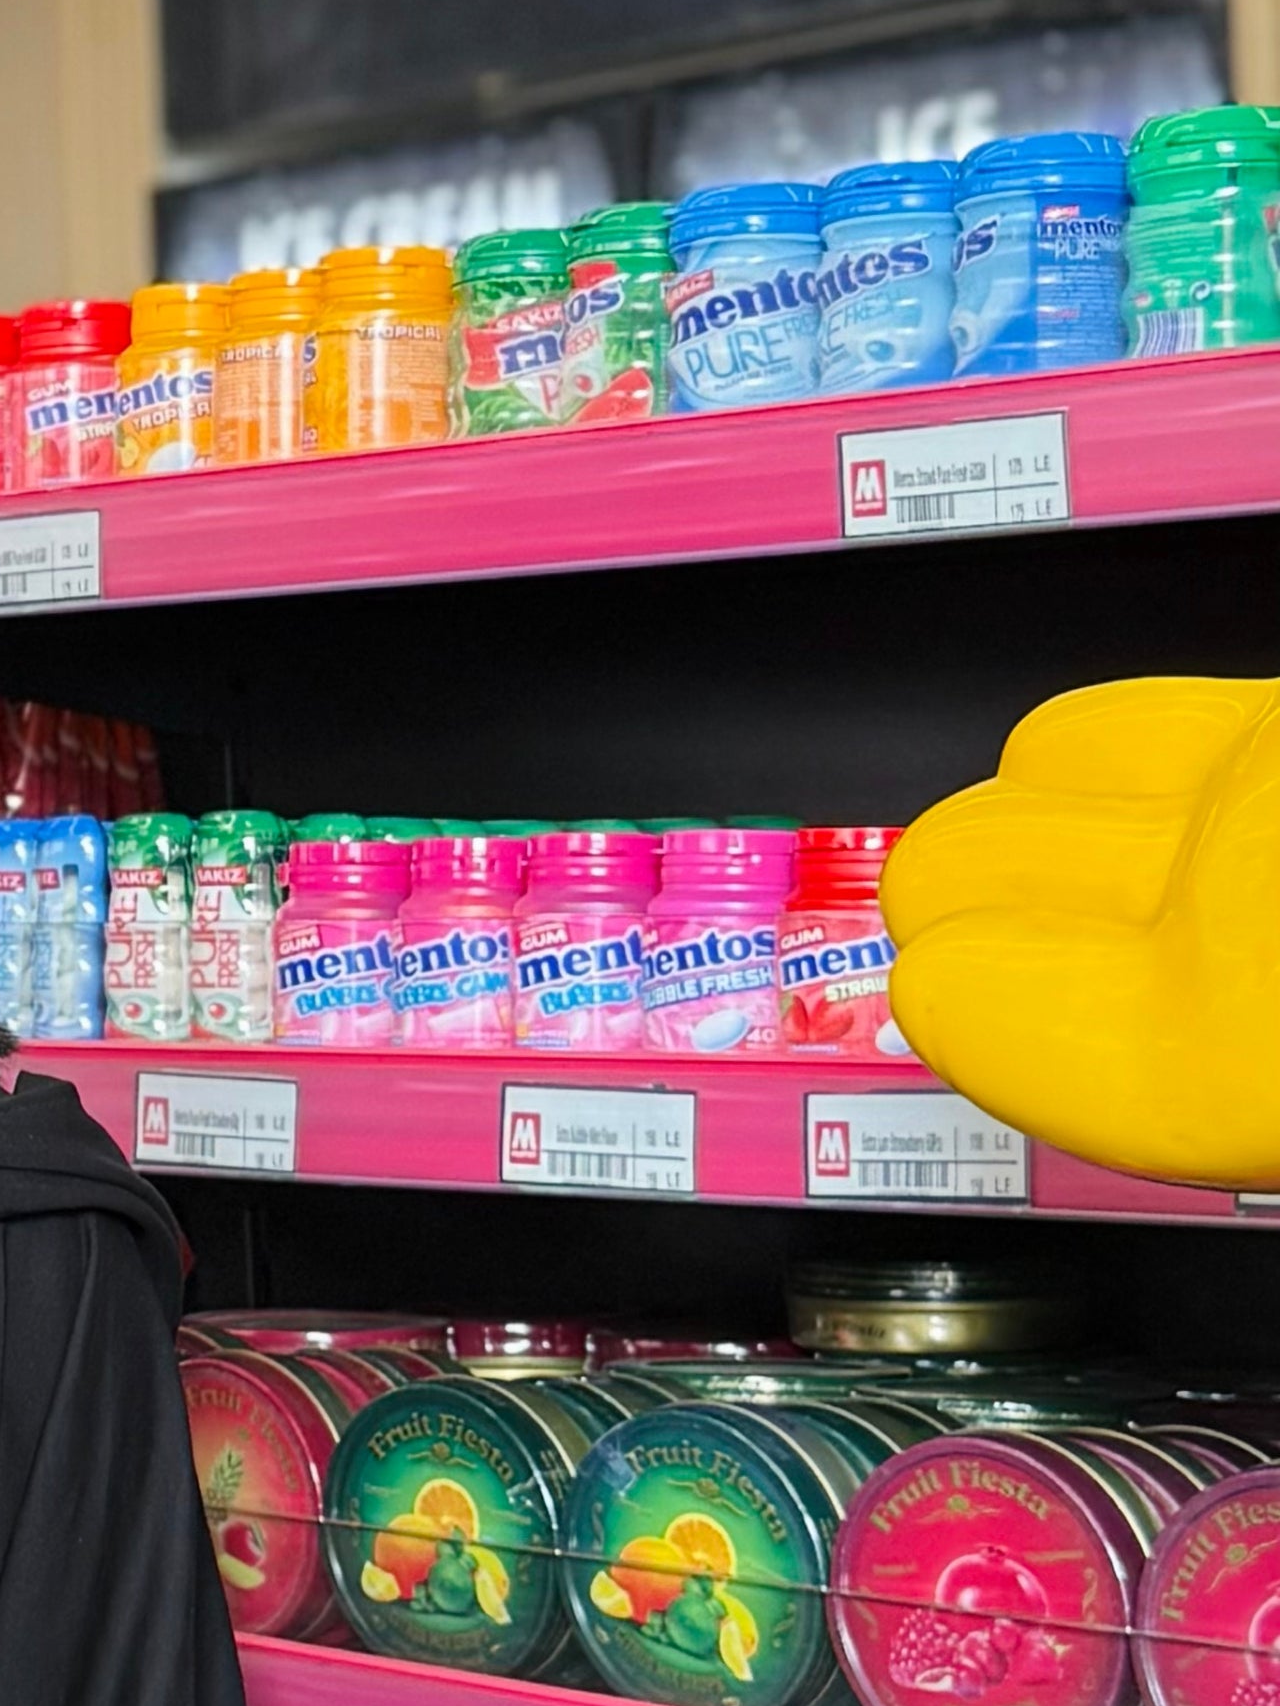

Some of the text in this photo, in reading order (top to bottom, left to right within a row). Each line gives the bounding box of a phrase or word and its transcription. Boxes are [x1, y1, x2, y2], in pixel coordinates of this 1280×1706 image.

[820, 240, 932, 305] ntos
[684, 326, 793, 388] PURE
[29, 390, 117, 431] men
[118, 369, 213, 415] entos
[133, 402, 212, 431] TROPICA
[107, 892, 138, 988] PURE
[133, 930, 157, 988] FRESH
[191, 890, 222, 988] PURE
[218, 930, 241, 988] FRESH
[278, 932, 391, 990] ment
[279, 933, 321, 955] GUM
[517, 929, 641, 989] ment
[519, 929, 568, 952] GUM
[780, 926, 825, 950] GUM
[781, 936, 898, 987] ment
[700, 967, 774, 996] FRESH
[368, 1412, 515, 1484] Fruit Fiesta
[626, 1440, 702, 1474] Fruit
[868, 1459, 1053, 1534] Fruit Fiesta
[1158, 1503, 1280, 1623] Fruit Fies
